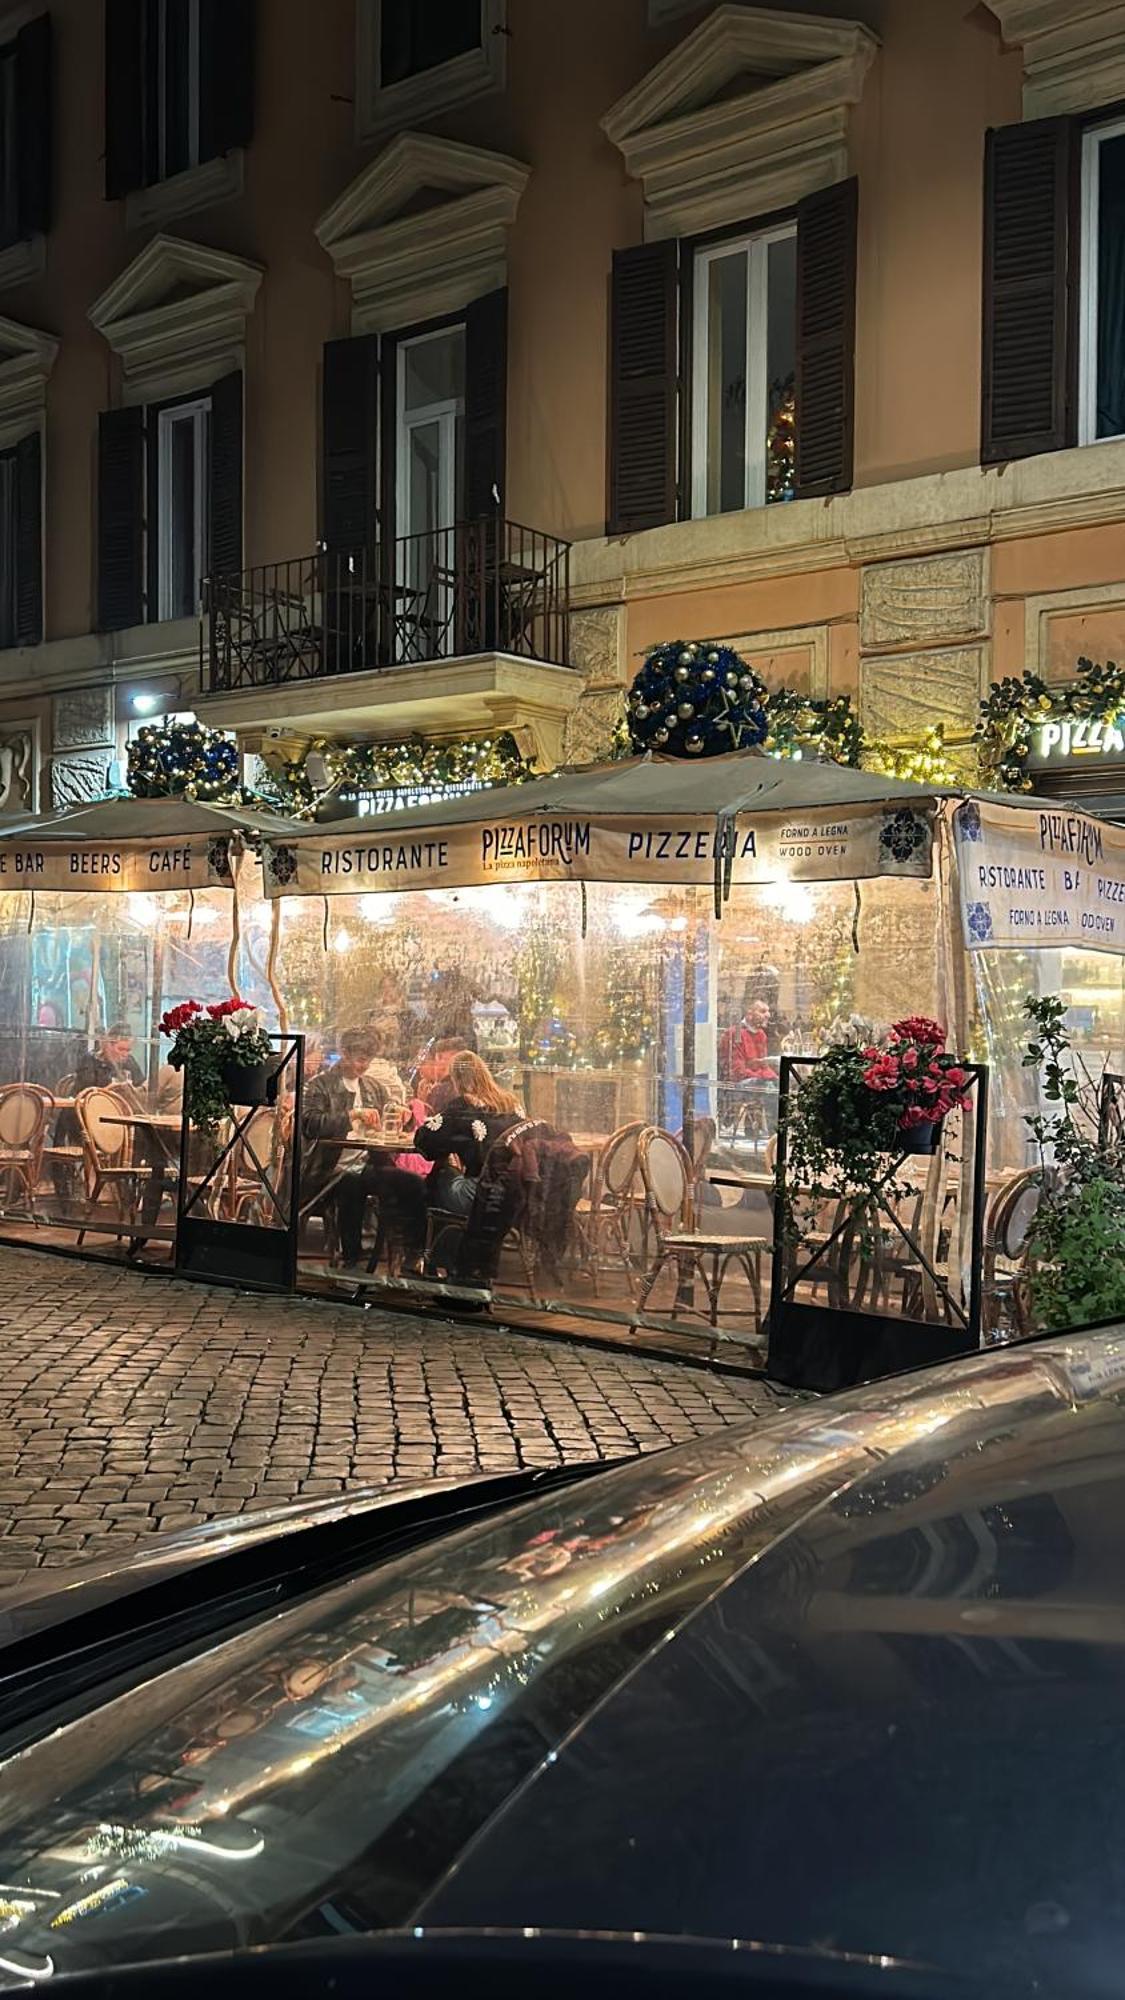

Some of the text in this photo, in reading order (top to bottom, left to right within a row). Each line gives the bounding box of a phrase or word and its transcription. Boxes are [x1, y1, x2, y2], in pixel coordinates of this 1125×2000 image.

[812, 827, 818, 837] A
[820, 825, 848, 837] LEGNA
[482, 822, 590, 865] PIZZAFORUM
[780, 845, 846, 857] WOOD OVEN
[15, 852, 44, 873] BAR
[70, 853, 121, 874] BEERS
[149, 842, 191, 873] CAFÉ
[322, 842, 448, 874] RISTORANTE
